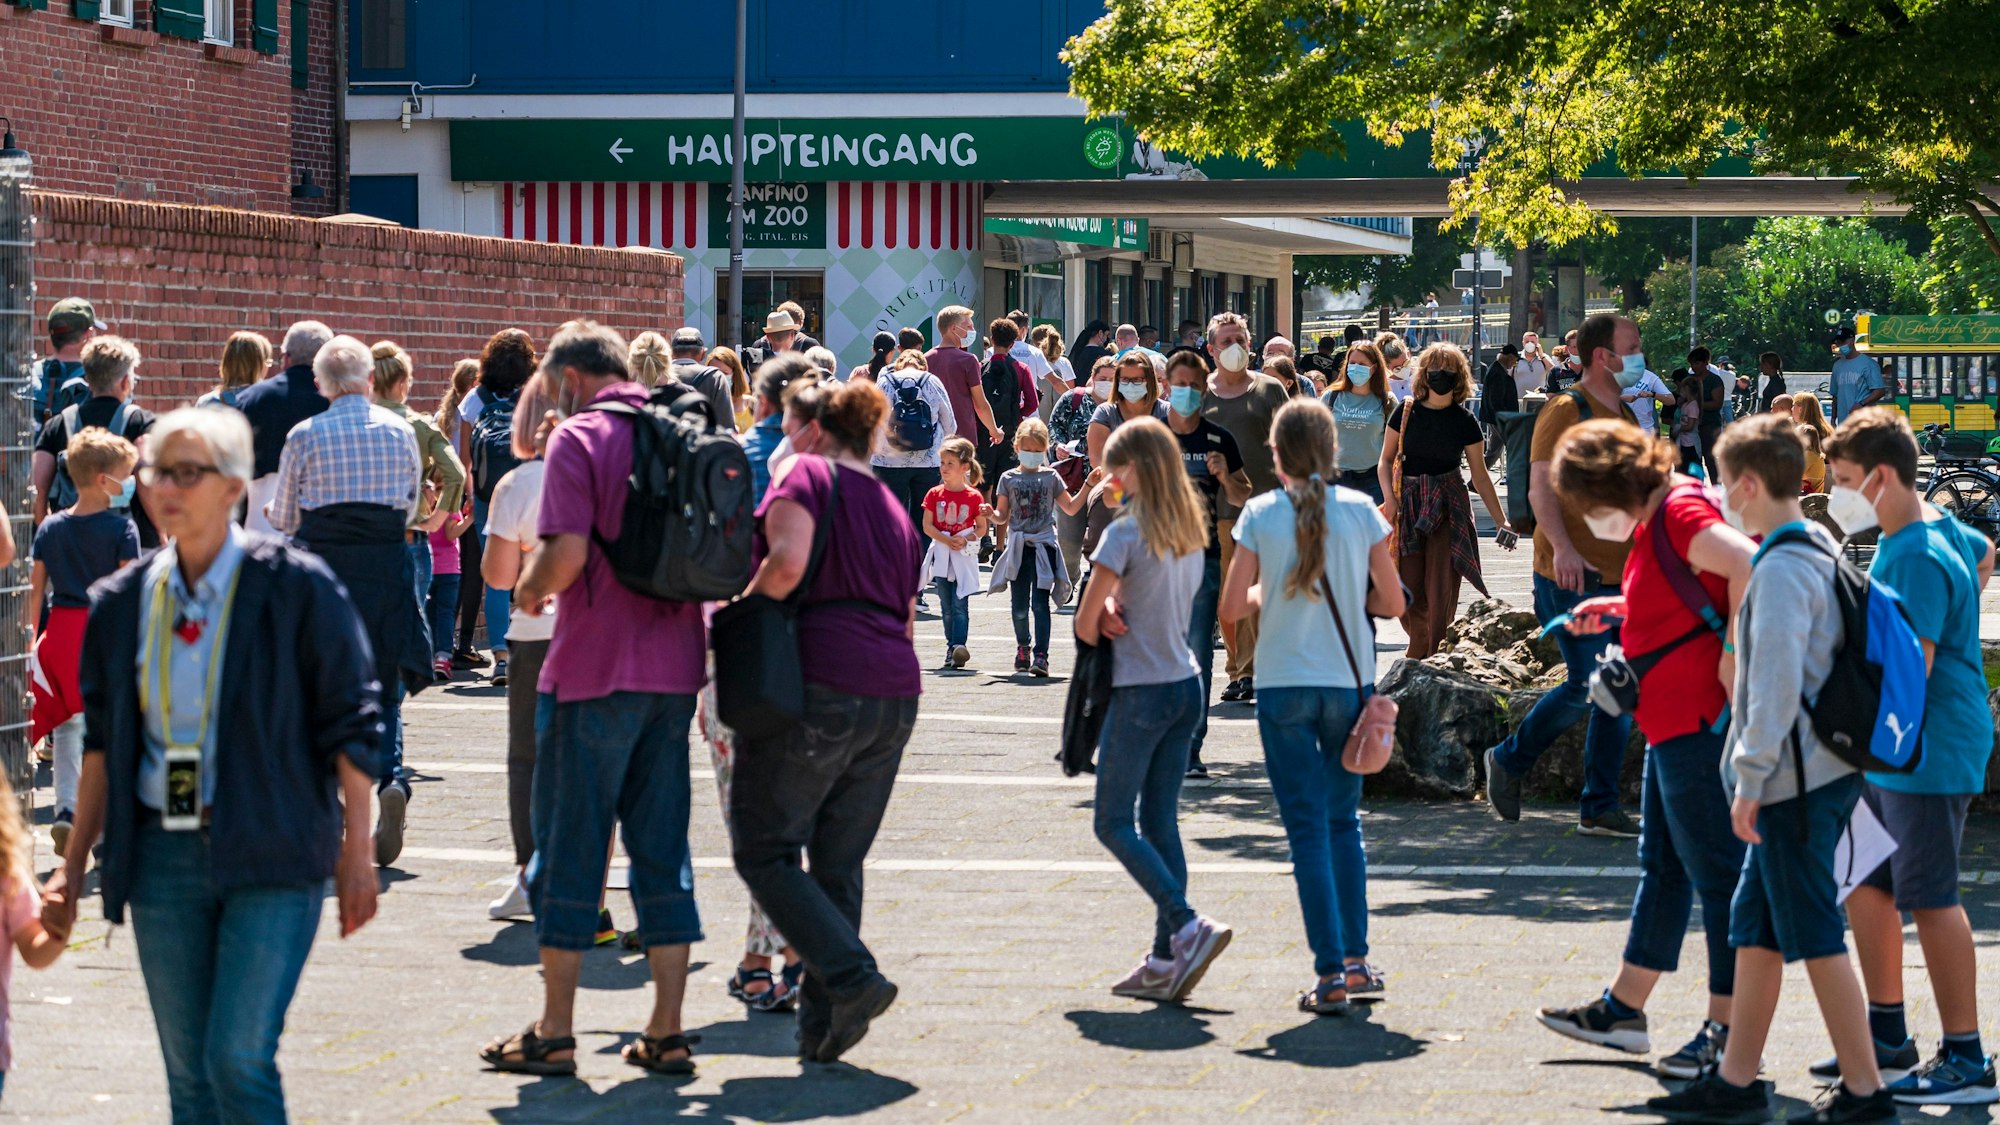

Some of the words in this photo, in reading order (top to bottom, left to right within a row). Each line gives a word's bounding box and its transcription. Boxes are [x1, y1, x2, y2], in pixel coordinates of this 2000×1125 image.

[668, 132, 978, 167] HAUPTEINGANG
[763, 205, 808, 226] ZOO
[726, 232, 756, 241] OIG.
[760, 232, 787, 241] ITAL.
[791, 232, 809, 241] EIS
[1828, 312, 1837, 322] H
[1342, 403, 1374, 416] Nothing
